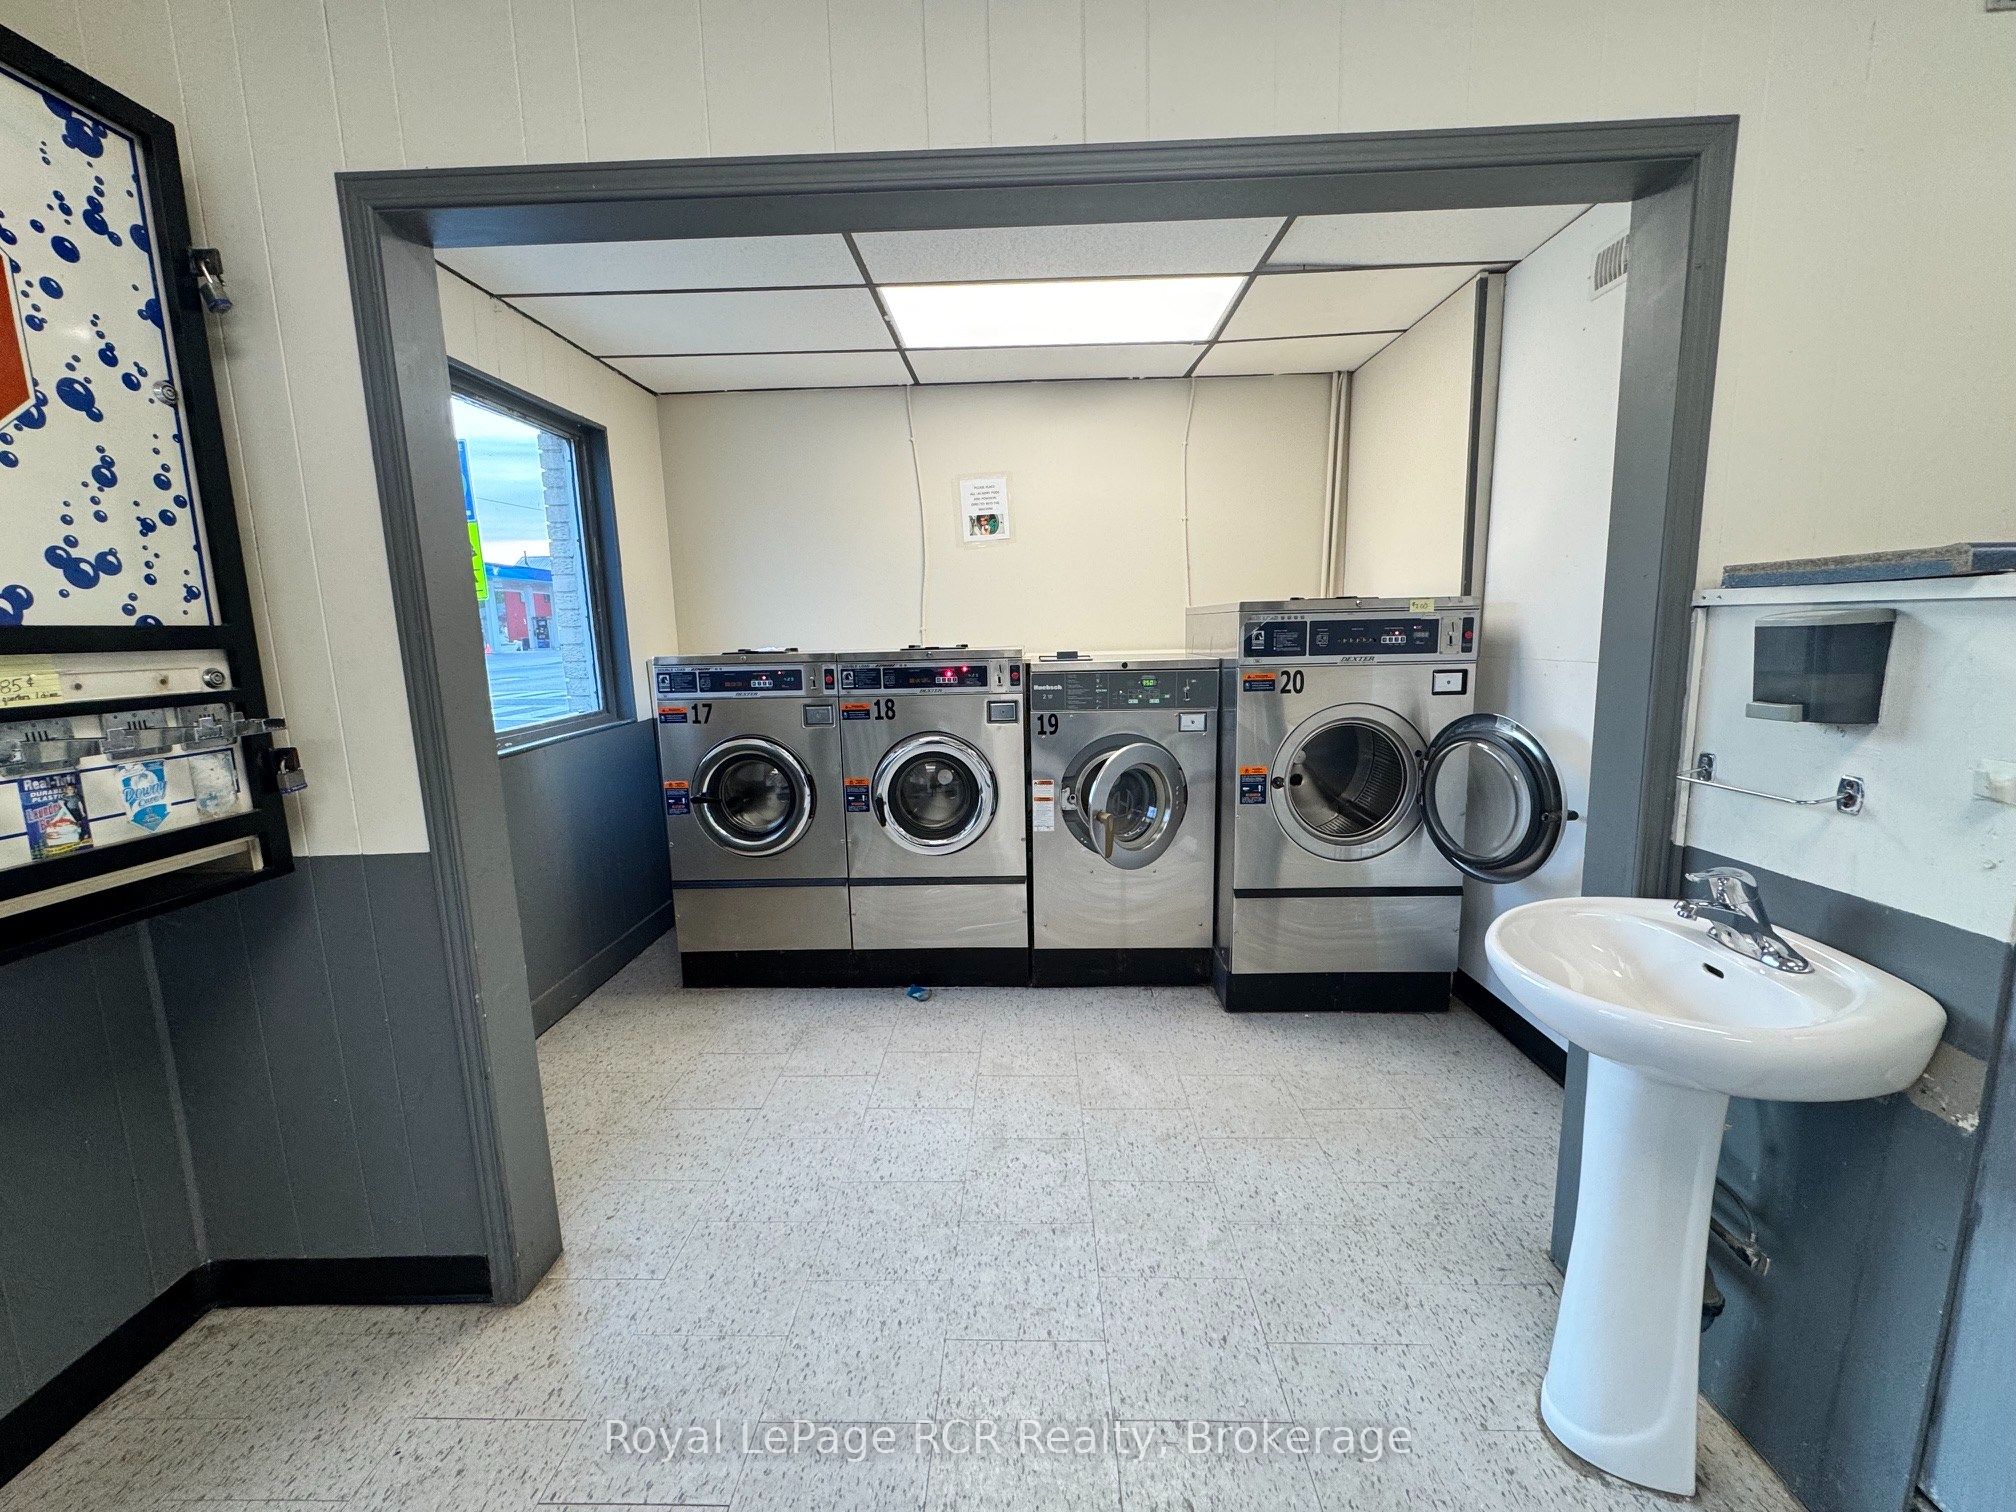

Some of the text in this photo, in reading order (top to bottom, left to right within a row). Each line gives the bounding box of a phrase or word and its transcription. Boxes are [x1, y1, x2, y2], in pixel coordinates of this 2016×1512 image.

[1280, 670, 1304, 694] 20
[691, 703, 713, 725] 17
[874, 699, 896, 720] 18
[1037, 713, 1059, 736] 19
[124, 780, 167, 803] Downy
